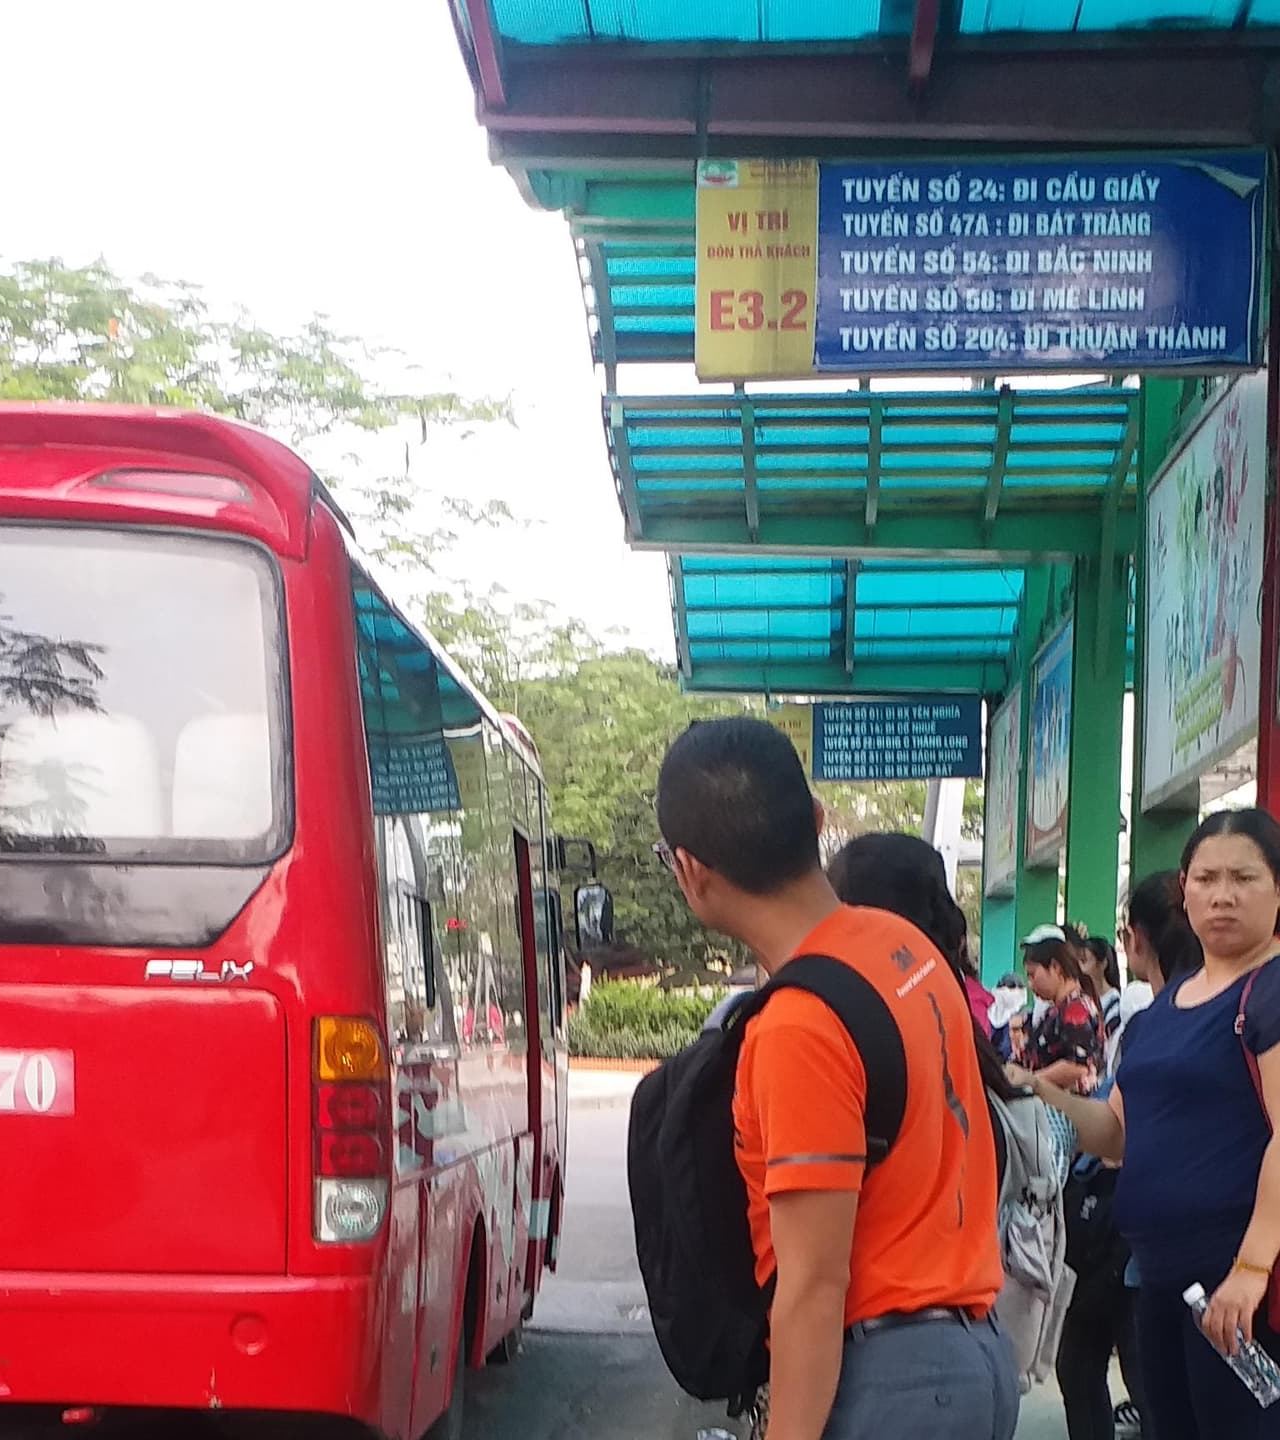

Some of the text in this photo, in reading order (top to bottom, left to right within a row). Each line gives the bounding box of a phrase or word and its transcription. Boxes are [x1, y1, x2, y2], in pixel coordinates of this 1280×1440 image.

[842, 171, 920, 203] TUYẾN
[928, 171, 961, 203] SỐ
[1103, 170, 1160, 201] GIẤY
[915, 206, 944, 237] SỐ
[924, 243, 956, 274] SỐ
[1093, 250, 1152, 274] NINH
[710, 288, 807, 331] E3.2
[1088, 288, 1144, 311] LINH
[144, 959, 254, 983] FELIX
